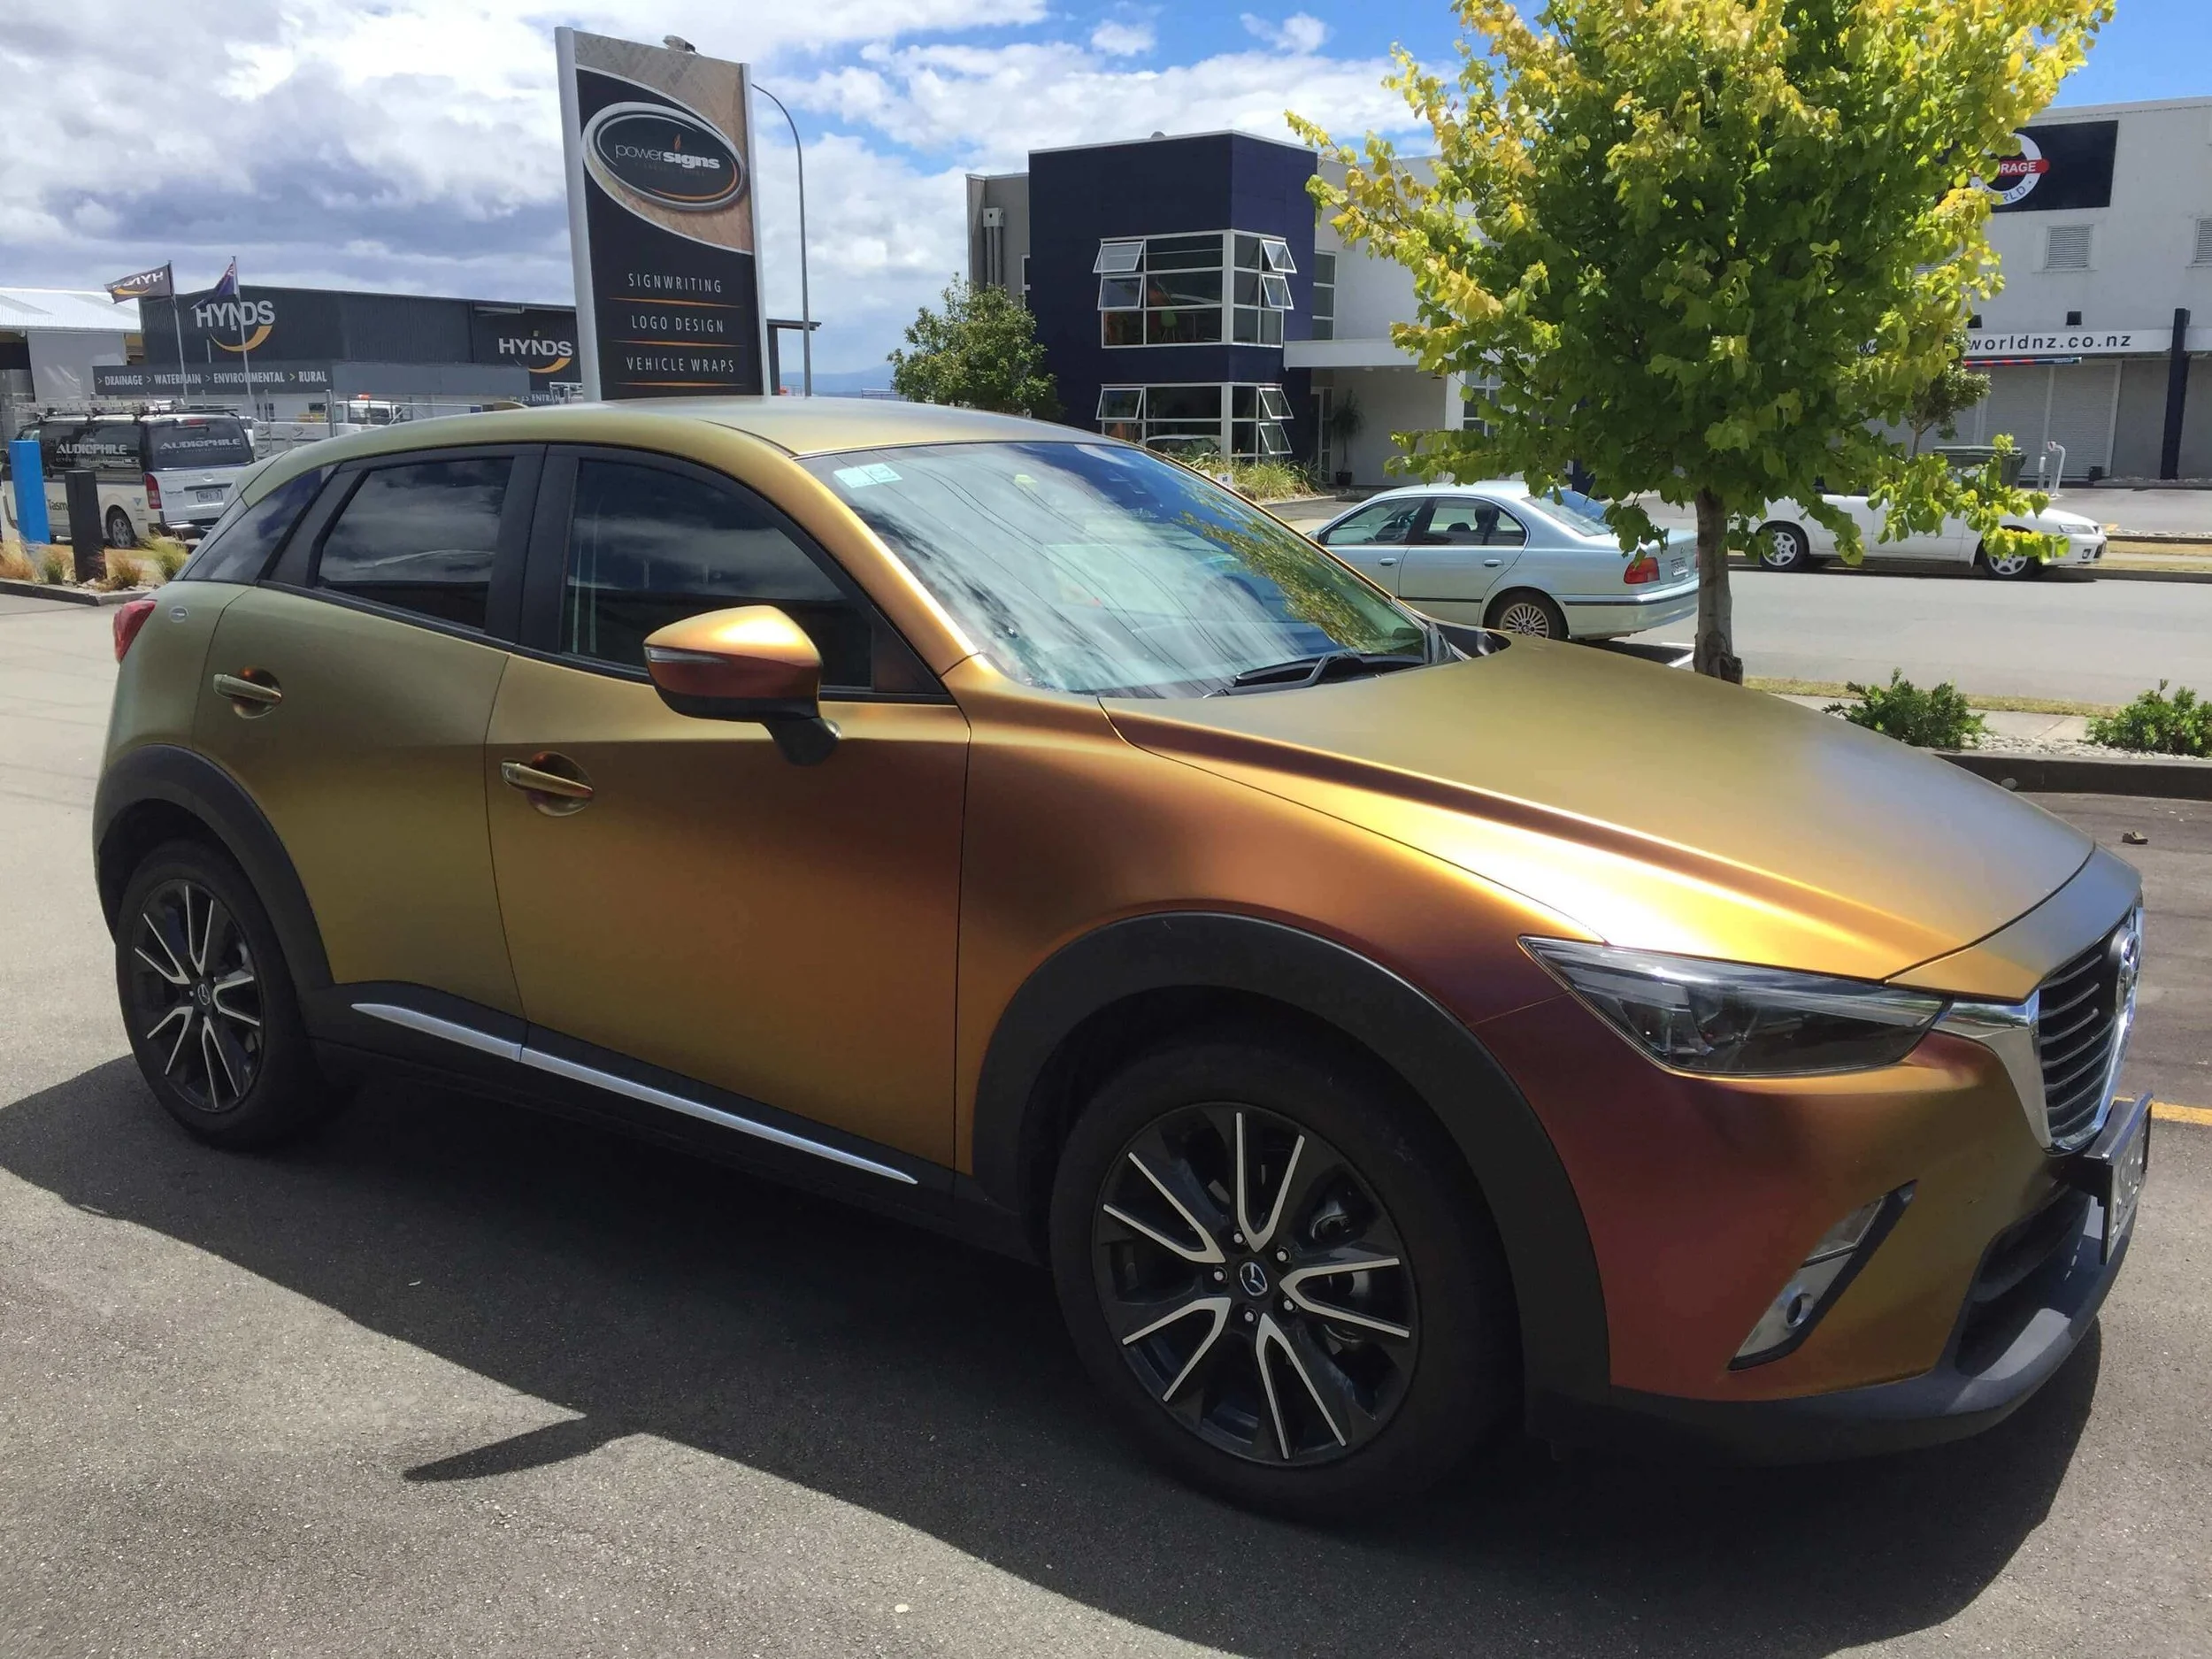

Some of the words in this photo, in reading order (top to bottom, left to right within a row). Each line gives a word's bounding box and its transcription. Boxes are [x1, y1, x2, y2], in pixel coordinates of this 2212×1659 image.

[615, 143, 720, 169] powersigns
[2001, 161, 2037, 174] RAGE
[628, 273, 721, 293] SIGNWRITING
[196, 300, 275, 328] HYNDS
[631, 315, 667, 330] LOGO
[675, 317, 723, 333] DESIGN
[498, 338, 572, 357] HYNDS
[626, 357, 684, 371] VEHICLE
[690, 358, 733, 373] WRAPS
[104, 375, 142, 386] DRAINAGE
[298, 371, 327, 382] RURAL
[56, 443, 127, 455] AUDIOPHILE
[159, 438, 242, 450] AUDIOPHILE
